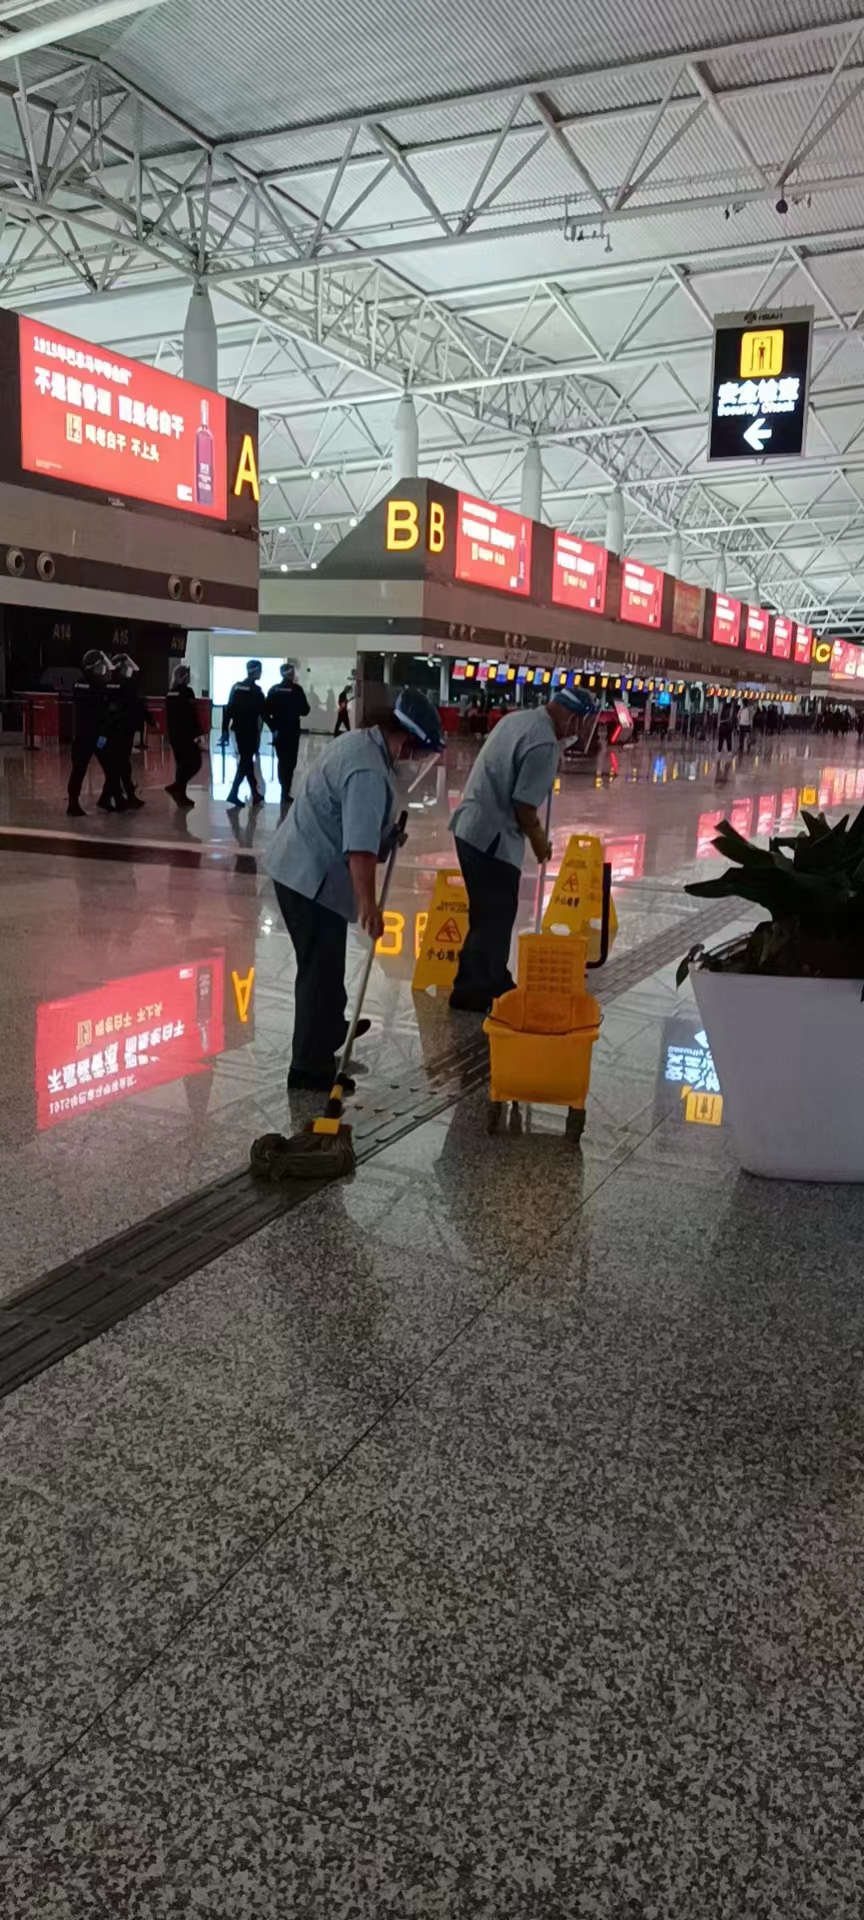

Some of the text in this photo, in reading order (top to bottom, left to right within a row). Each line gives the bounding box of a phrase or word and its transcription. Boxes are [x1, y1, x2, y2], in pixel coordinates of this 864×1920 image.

[233, 434, 260, 503] A
[386, 500, 420, 551] B
[430, 502, 445, 552] B
[53, 623, 72, 642] A14
[815, 643, 831, 664] C
[427, 947, 457, 962] 小心地
